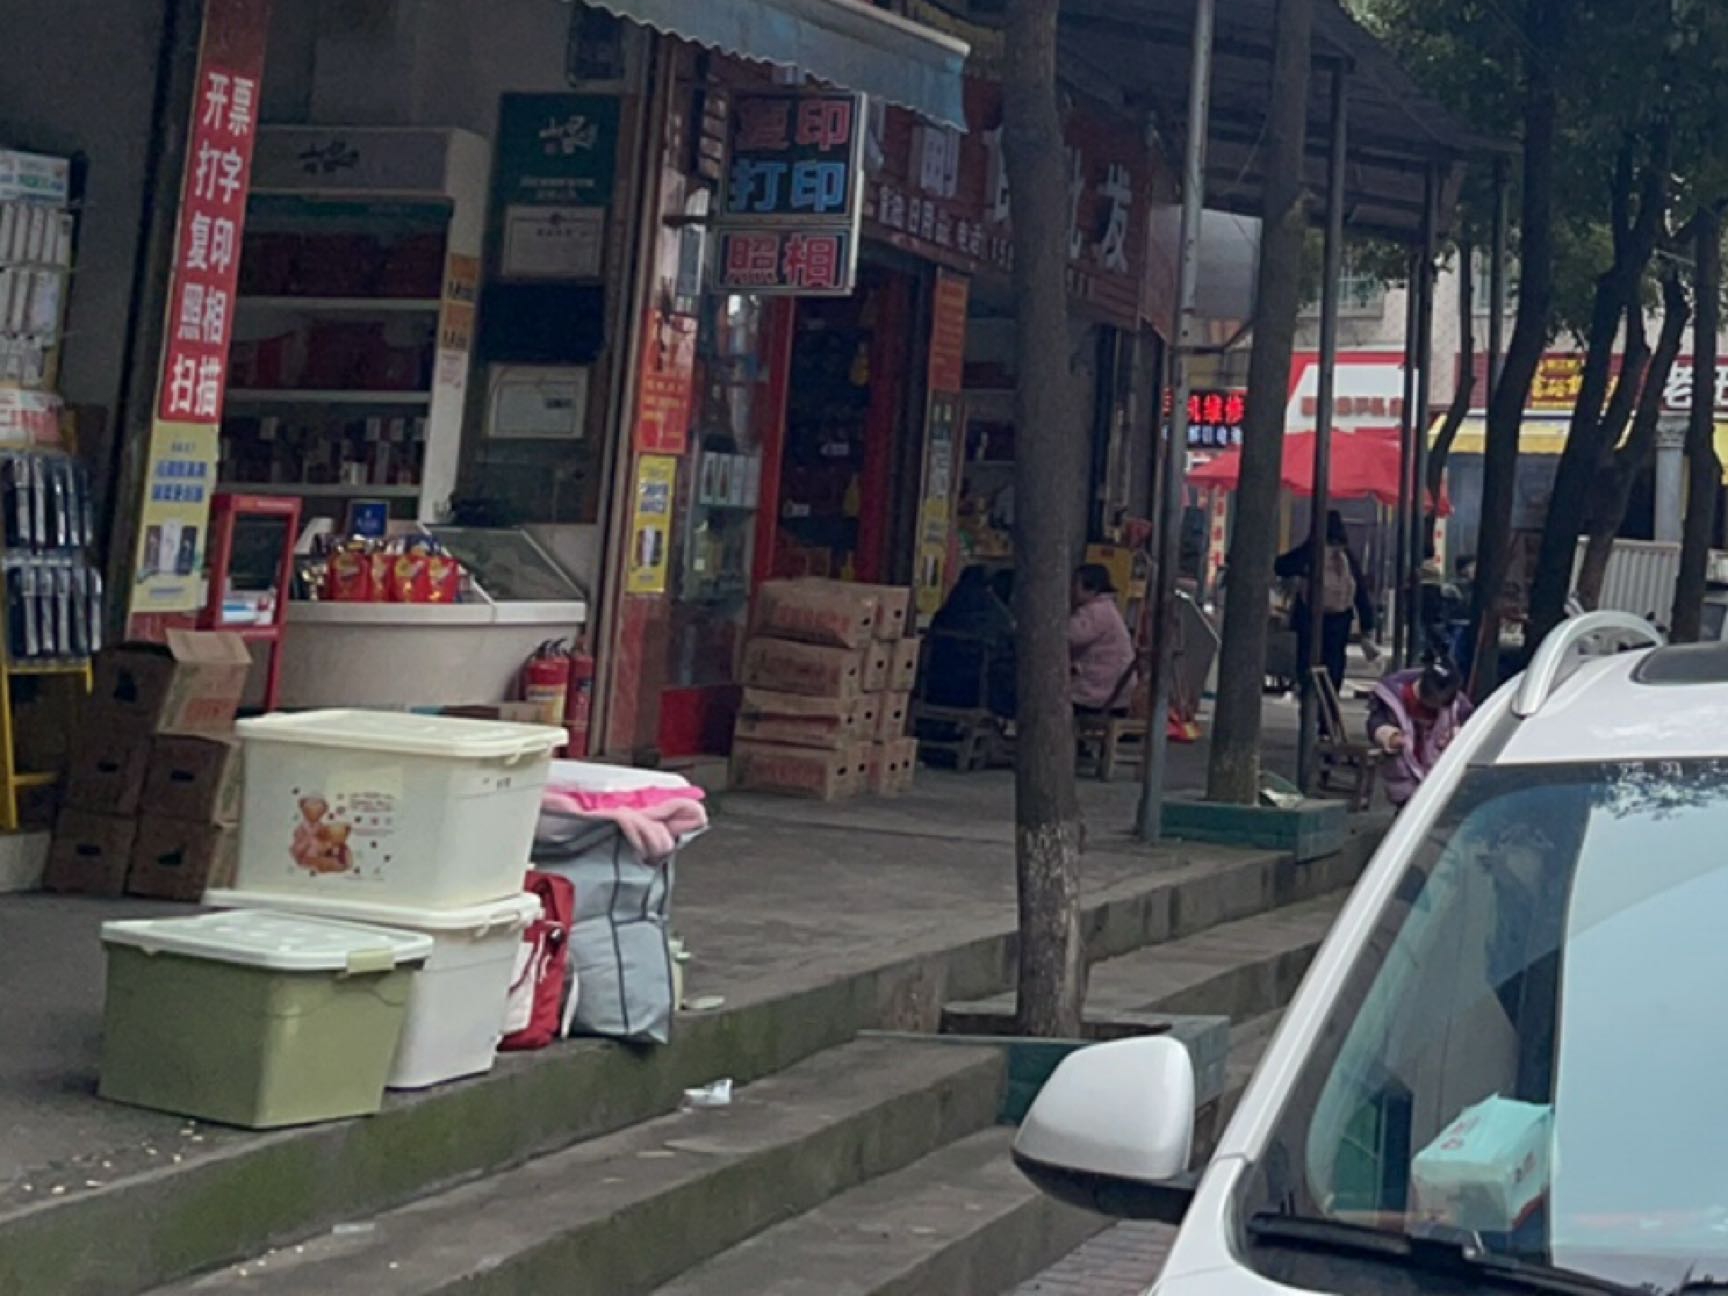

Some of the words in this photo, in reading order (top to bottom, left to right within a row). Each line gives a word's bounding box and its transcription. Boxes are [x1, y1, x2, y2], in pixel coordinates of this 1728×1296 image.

[204, 72, 255, 136] 开票
[196, 140, 244, 204] 打字
[728, 159, 846, 213] 打印
[186, 210, 235, 274] 复印
[727, 232, 838, 287] 照相
[178, 283, 226, 345] 照相
[170, 354, 221, 417] 扫描
